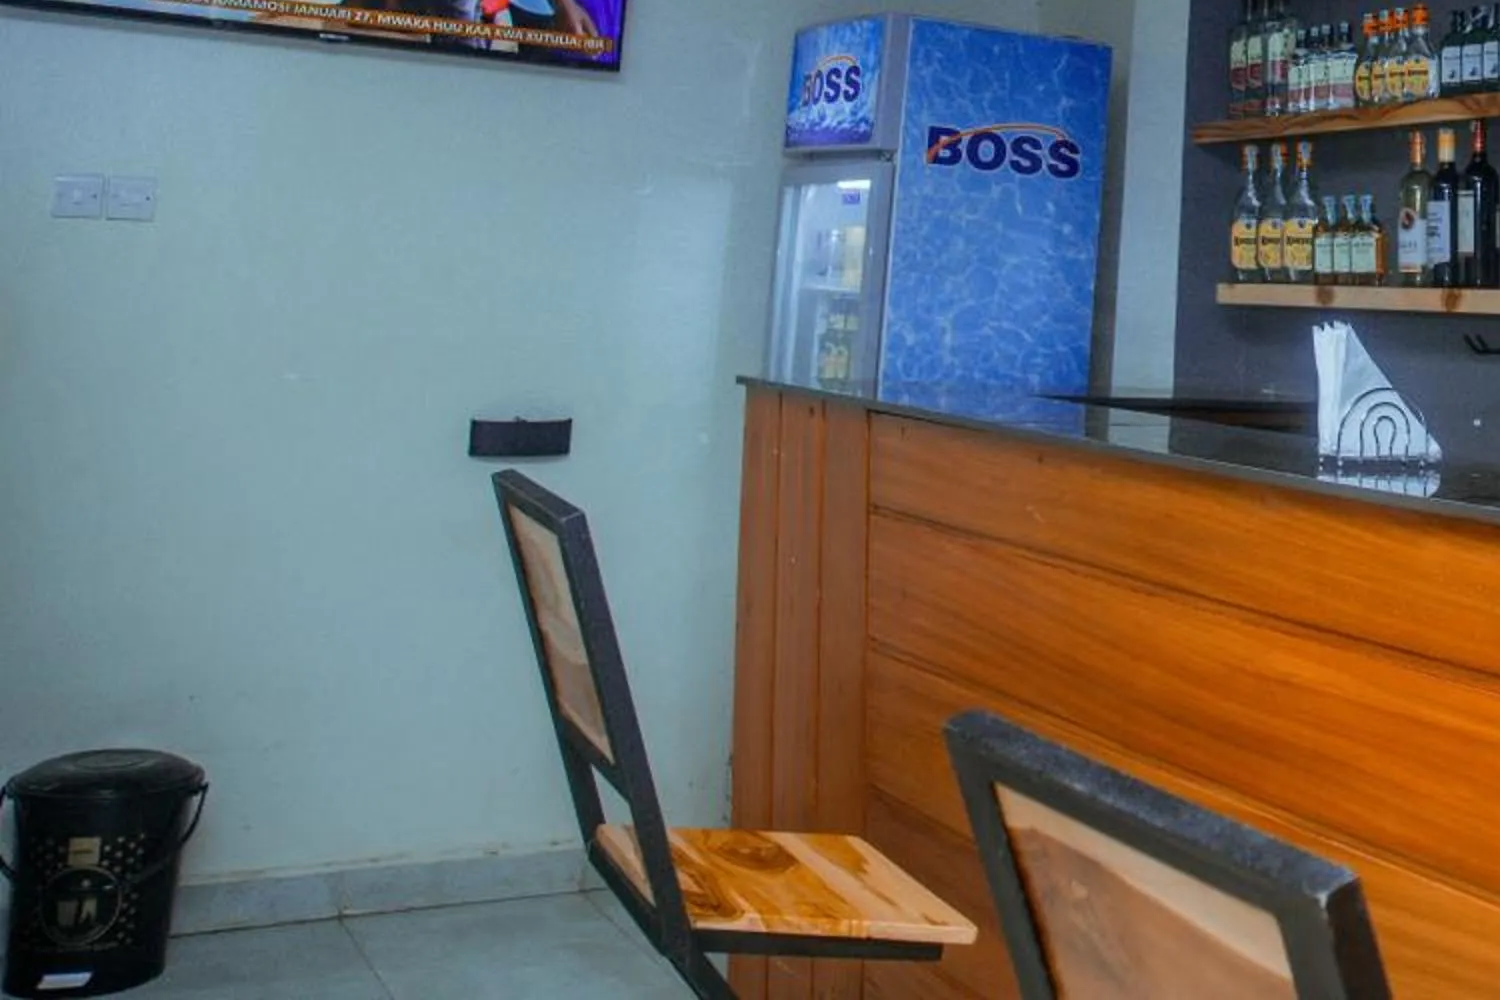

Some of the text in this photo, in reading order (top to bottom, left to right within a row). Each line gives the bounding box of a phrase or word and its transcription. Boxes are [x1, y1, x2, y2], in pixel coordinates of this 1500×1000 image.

[293, 3, 350, 19] JANUARI
[377, 13, 431, 29] MWAKA
[802, 64, 861, 107] BOSS
[928, 126, 1081, 179] BOSS
